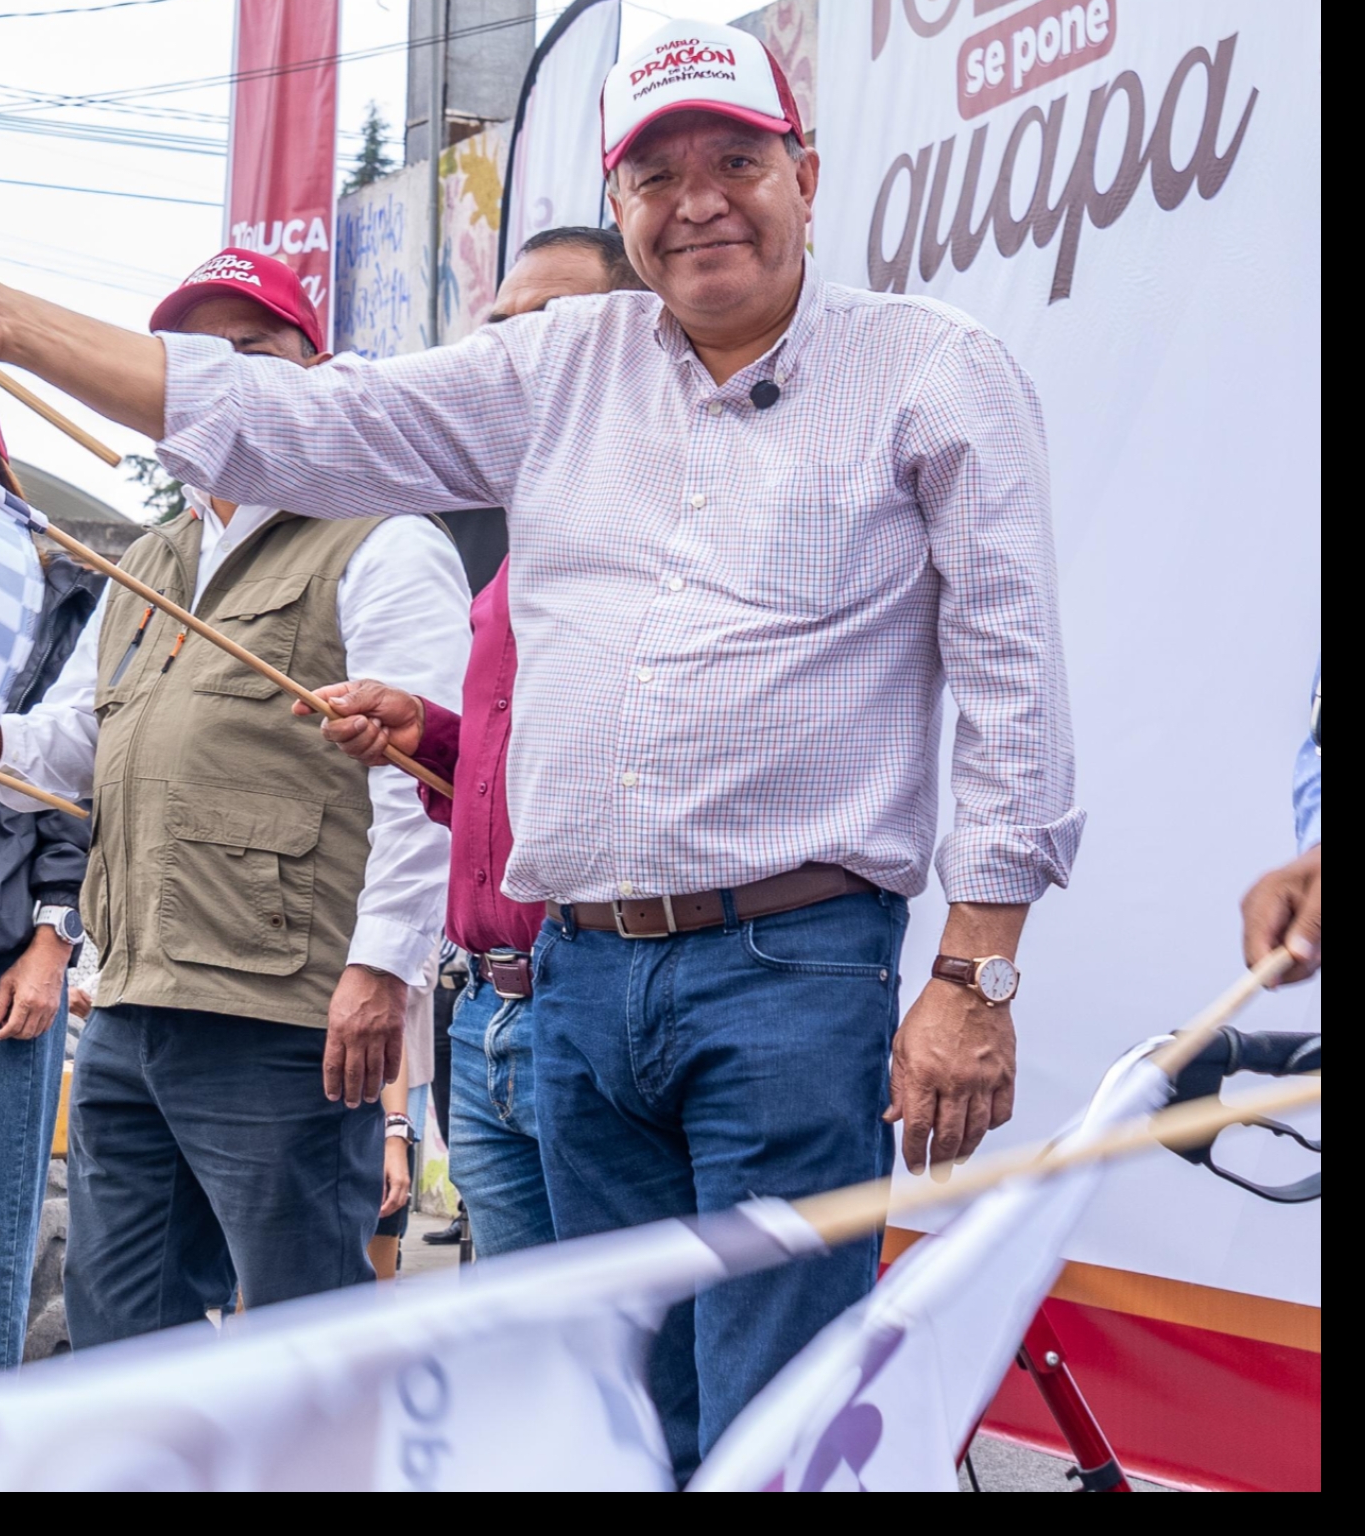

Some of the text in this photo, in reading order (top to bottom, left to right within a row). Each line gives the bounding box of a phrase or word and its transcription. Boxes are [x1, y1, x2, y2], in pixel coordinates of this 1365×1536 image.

[655, 38, 700, 55] DIABLO
[629, 46, 736, 86] DRAGÓN
[668, 68, 681, 76] DE
[966, 39, 1006, 95] se
[633, 69, 736, 101] PAVIMENTACIÓN
[866, 31, 1260, 307] guapa
